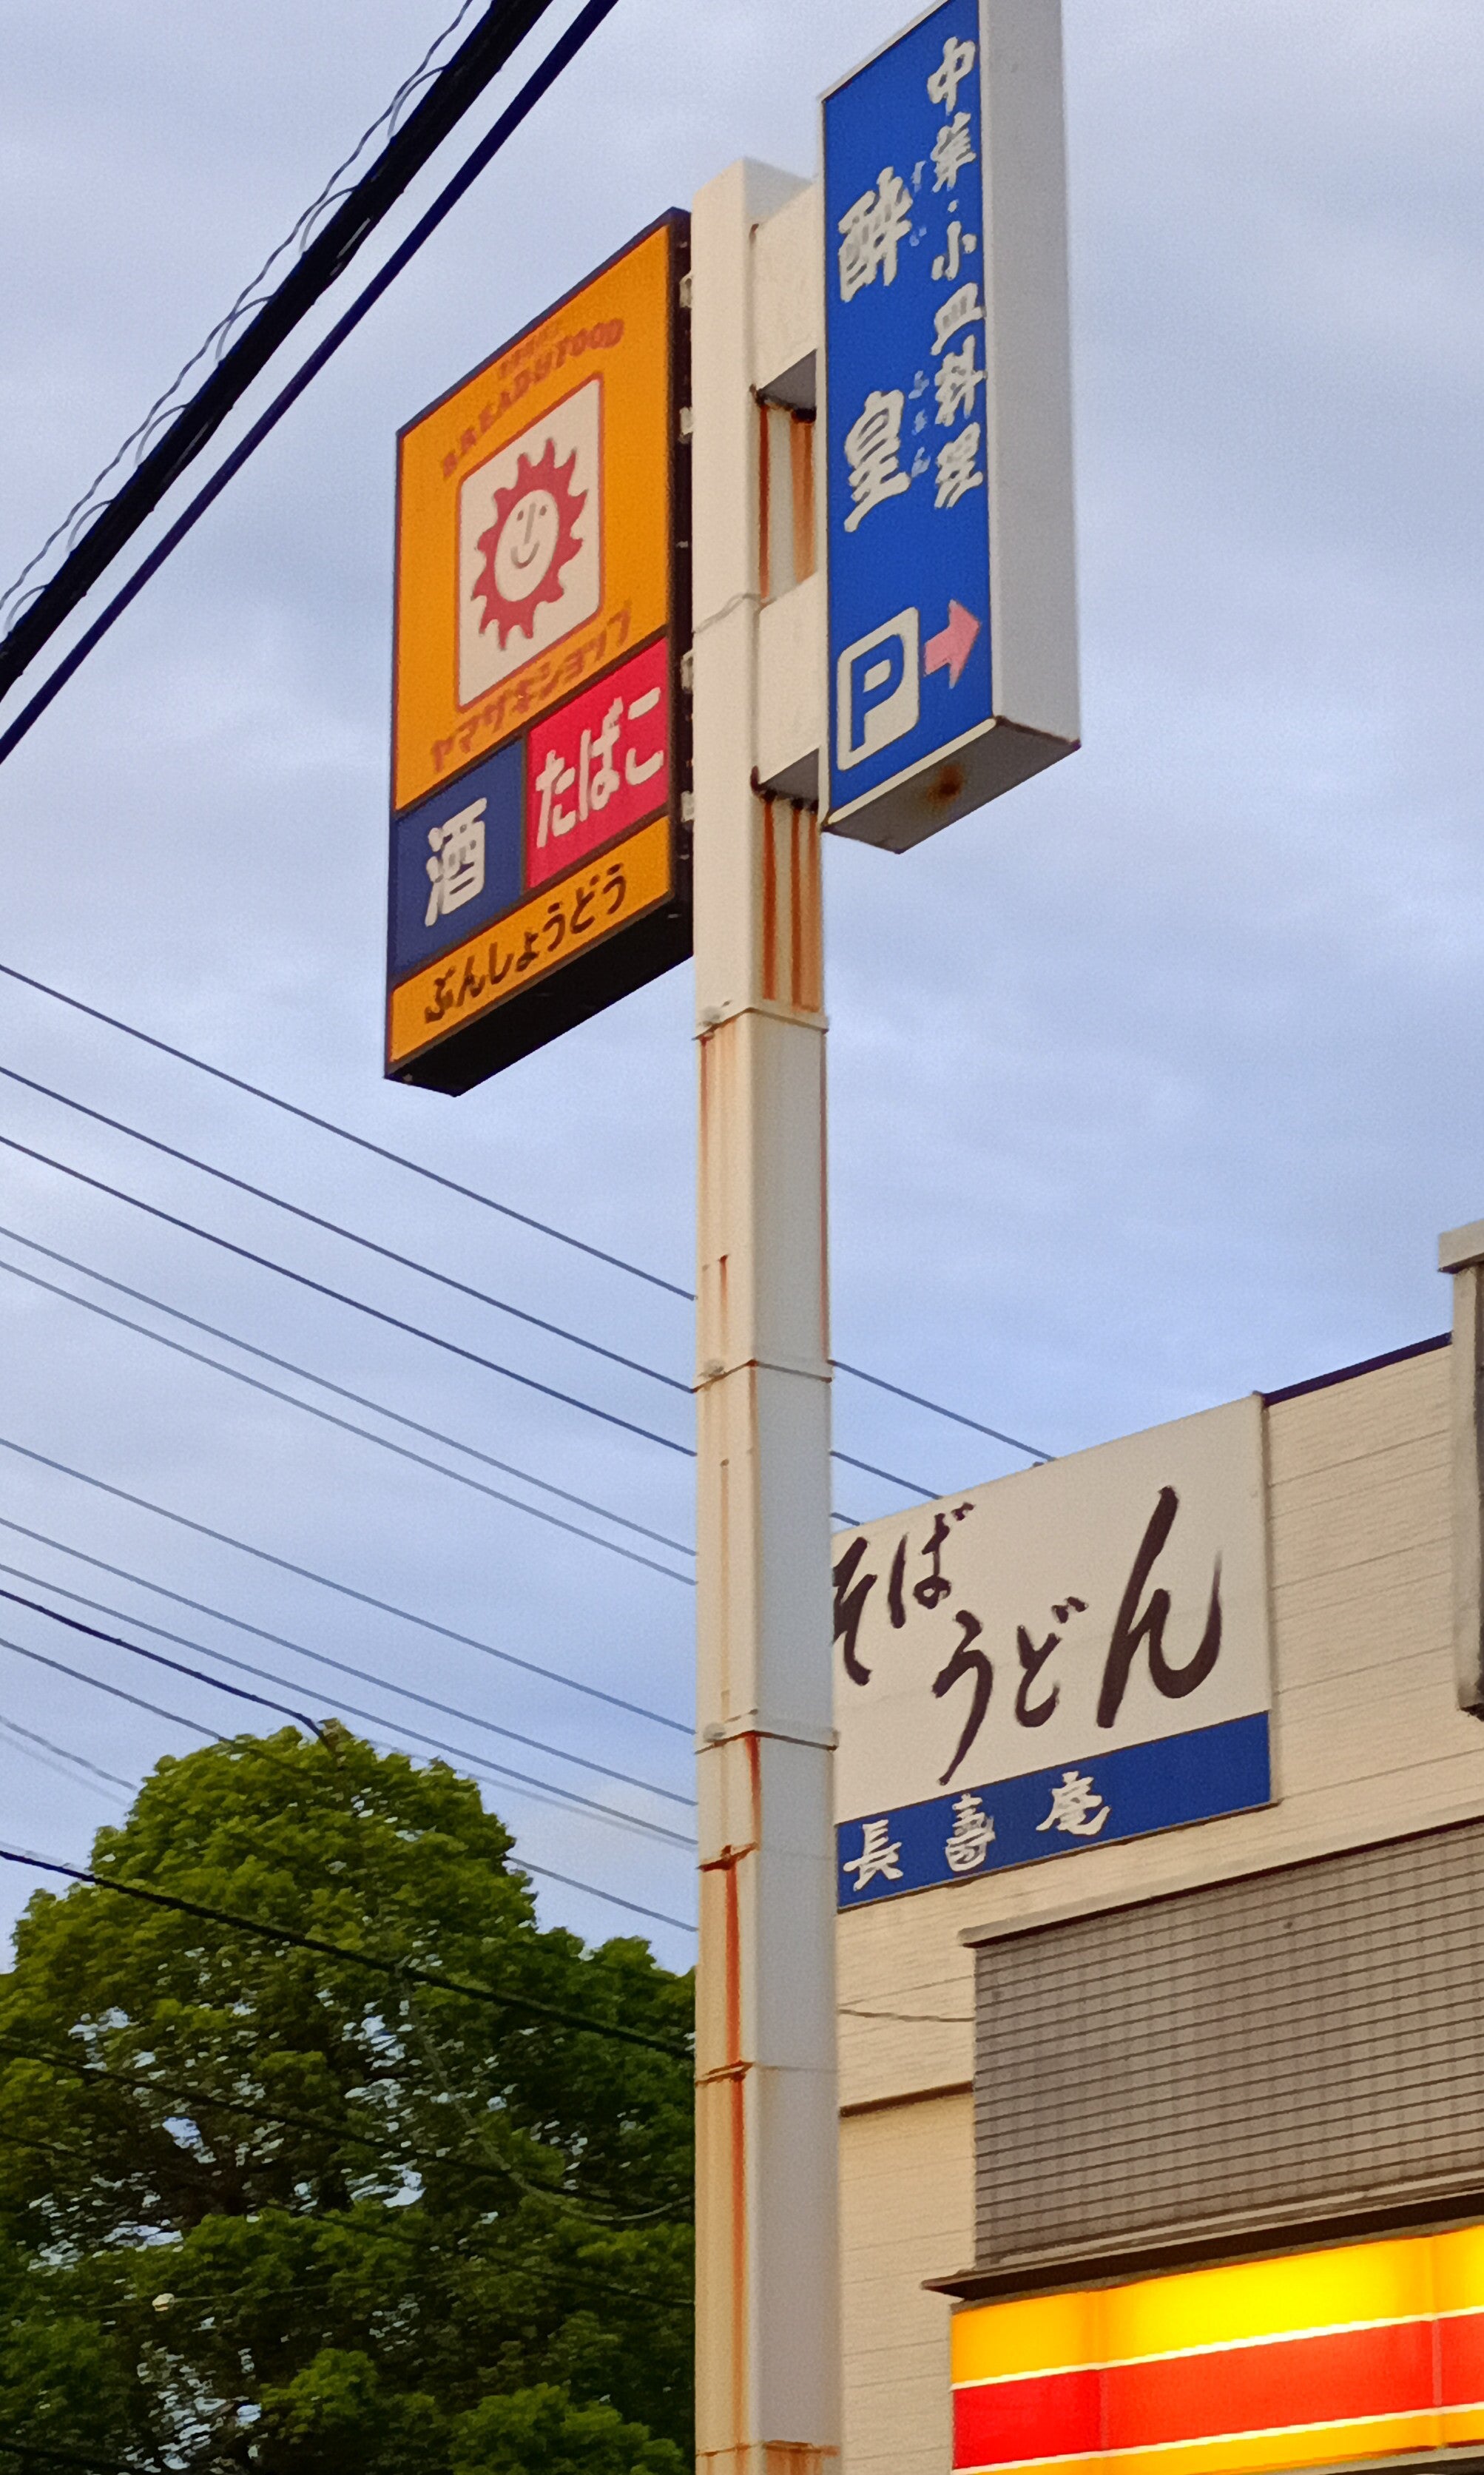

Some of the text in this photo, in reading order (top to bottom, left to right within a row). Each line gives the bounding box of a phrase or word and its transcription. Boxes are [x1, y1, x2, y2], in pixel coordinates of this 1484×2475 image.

[431, 598, 633, 774] ヤマザキショップ
[851, 634, 905, 752] P
[536, 687, 664, 849] たばこ
[425, 797, 487, 927] 酒
[425, 863, 627, 1024] ぶんしょうどう
[931, 1485, 1223, 1786] うどん
